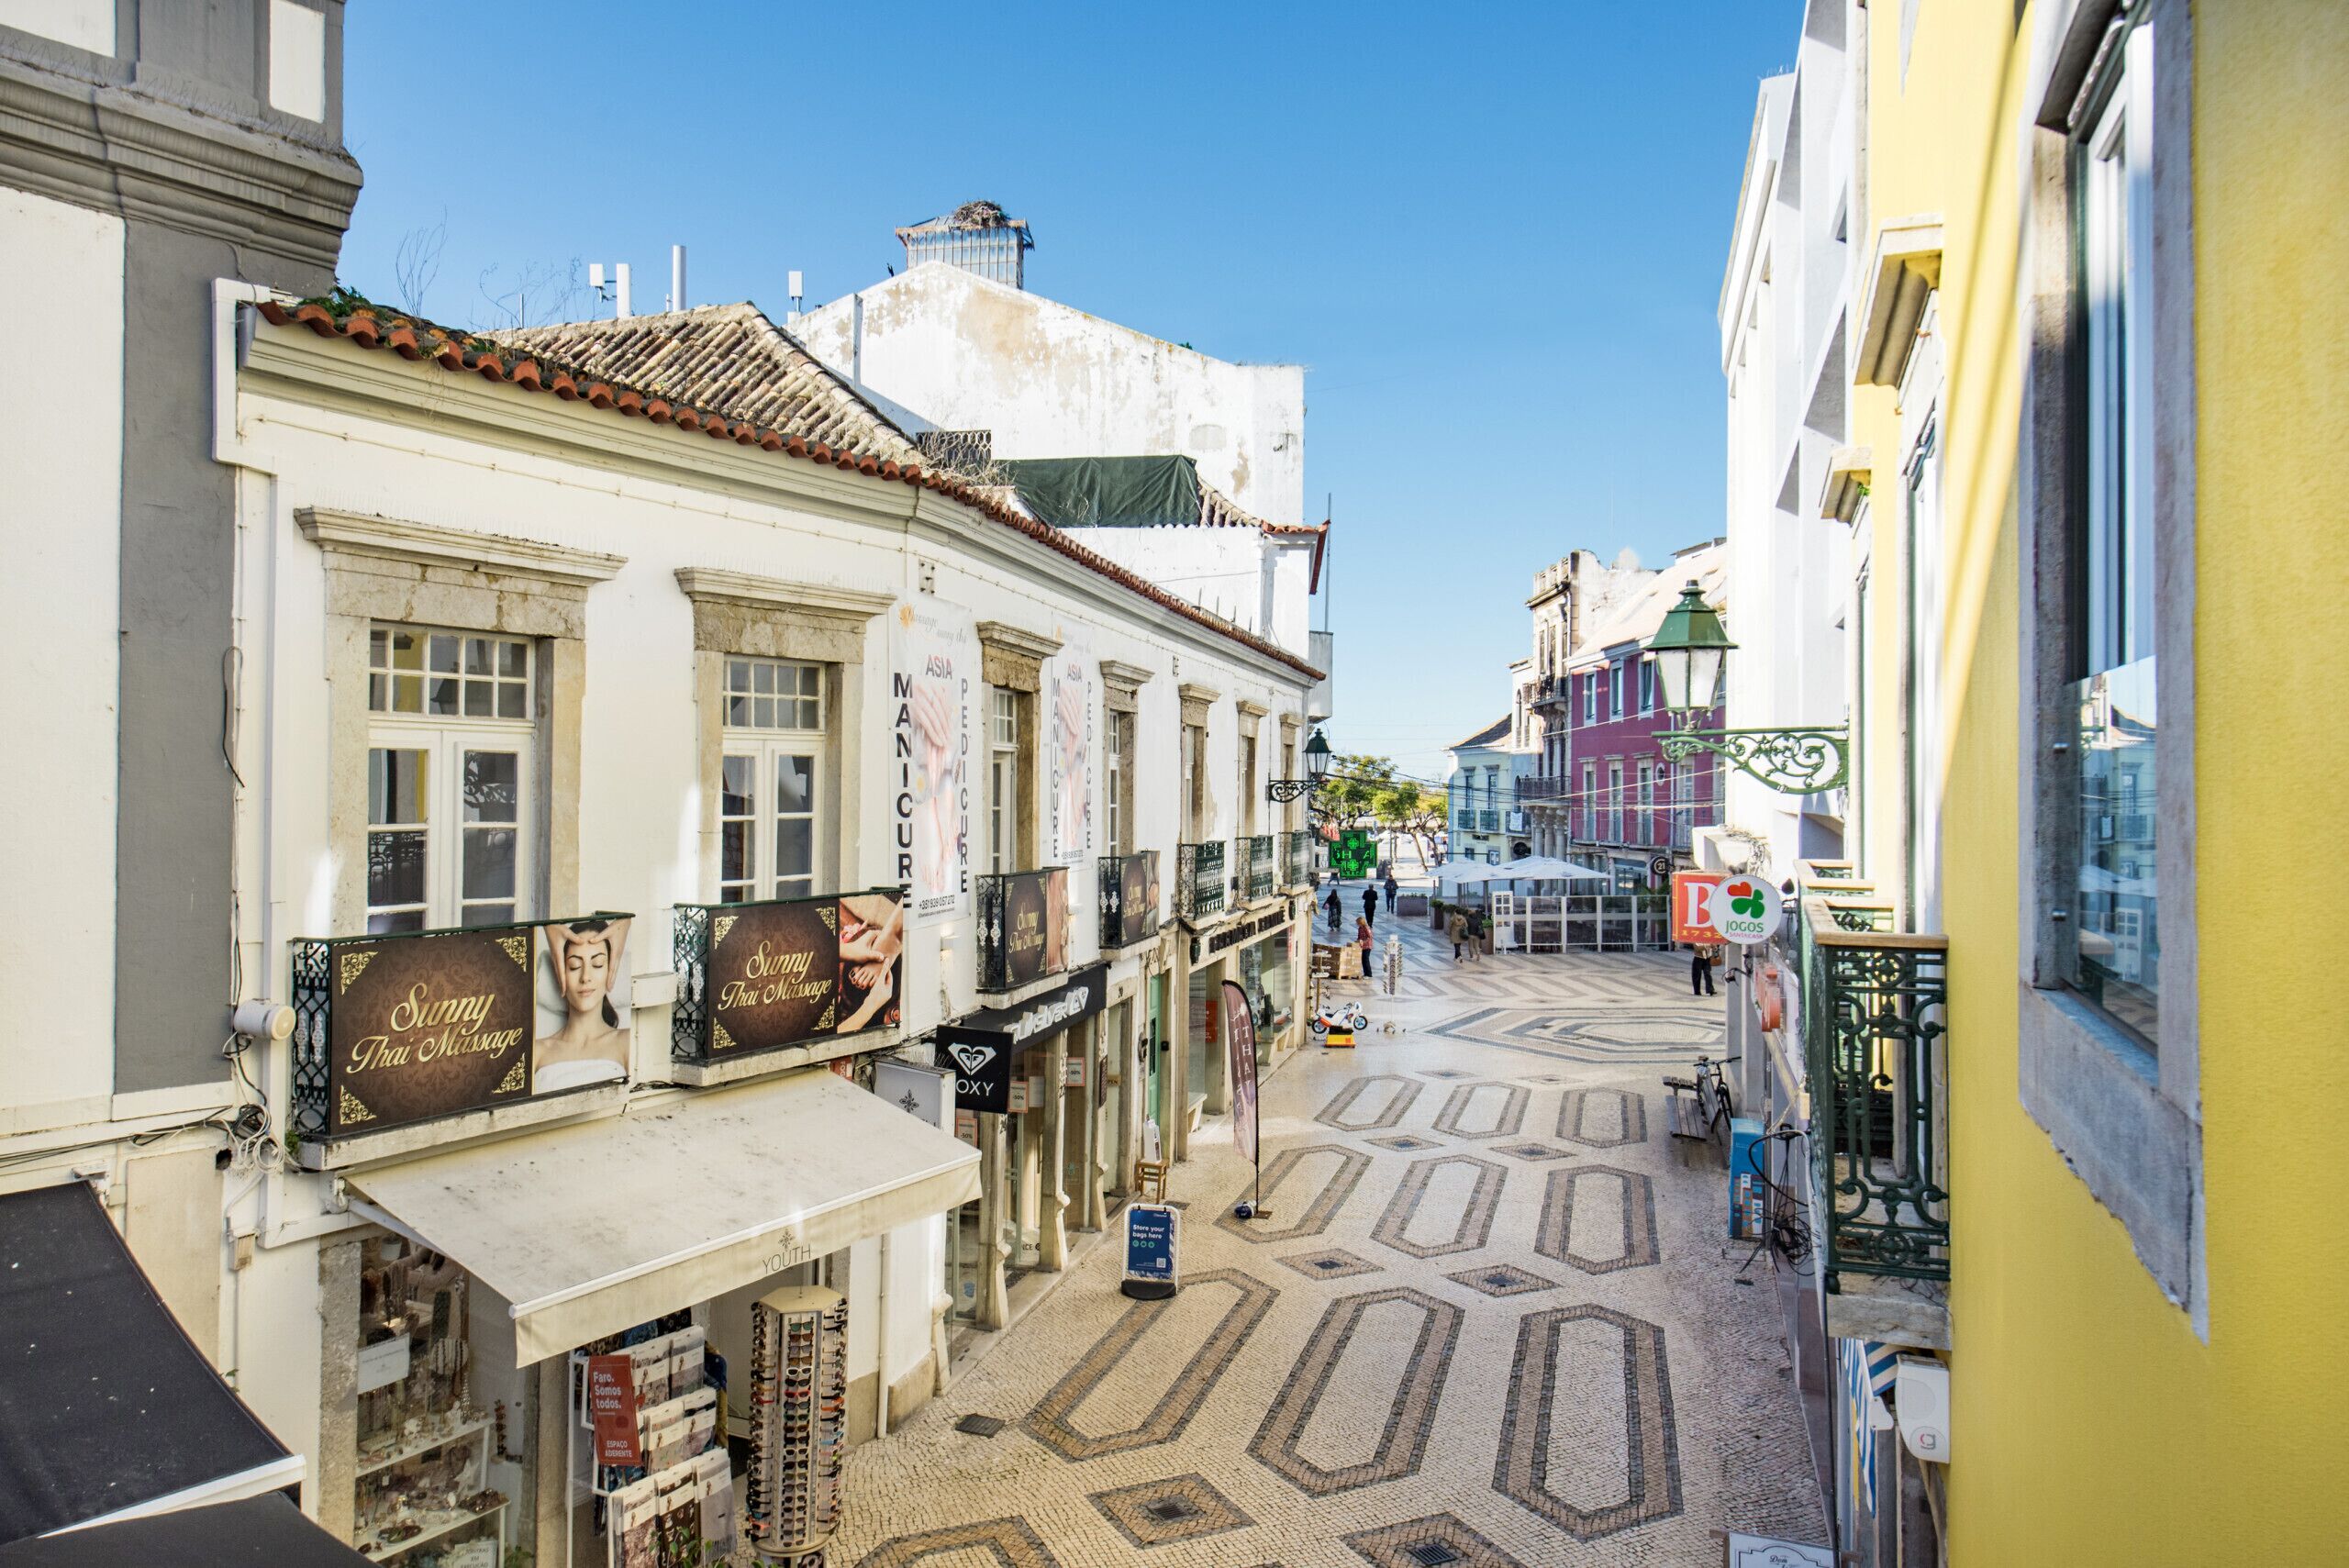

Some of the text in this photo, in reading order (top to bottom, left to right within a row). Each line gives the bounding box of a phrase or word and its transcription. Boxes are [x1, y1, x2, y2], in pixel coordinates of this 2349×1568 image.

[926, 654, 952, 680] ASIA
[1067, 664, 1082, 683] ASIA
[894, 673, 913, 908] MANICURE
[960, 678, 968, 893] PEDICURE
[1725, 920, 1764, 933] JOGOS
[747, 940, 814, 984] Sunny
[718, 975, 832, 1010] Thai Massage
[390, 983, 495, 1036] Sunny
[345, 1024, 523, 1073] Thai Massage
[956, 1079, 994, 1096] OXY
[763, 1243, 810, 1274] YOUTH
[593, 1372, 615, 1383] Faro.
[595, 1385, 621, 1396] Somos
[596, 1398, 622, 1409] todos.
[605, 1450, 632, 1458] ADERENTE
[607, 1440, 628, 1450] ESPAÇO
